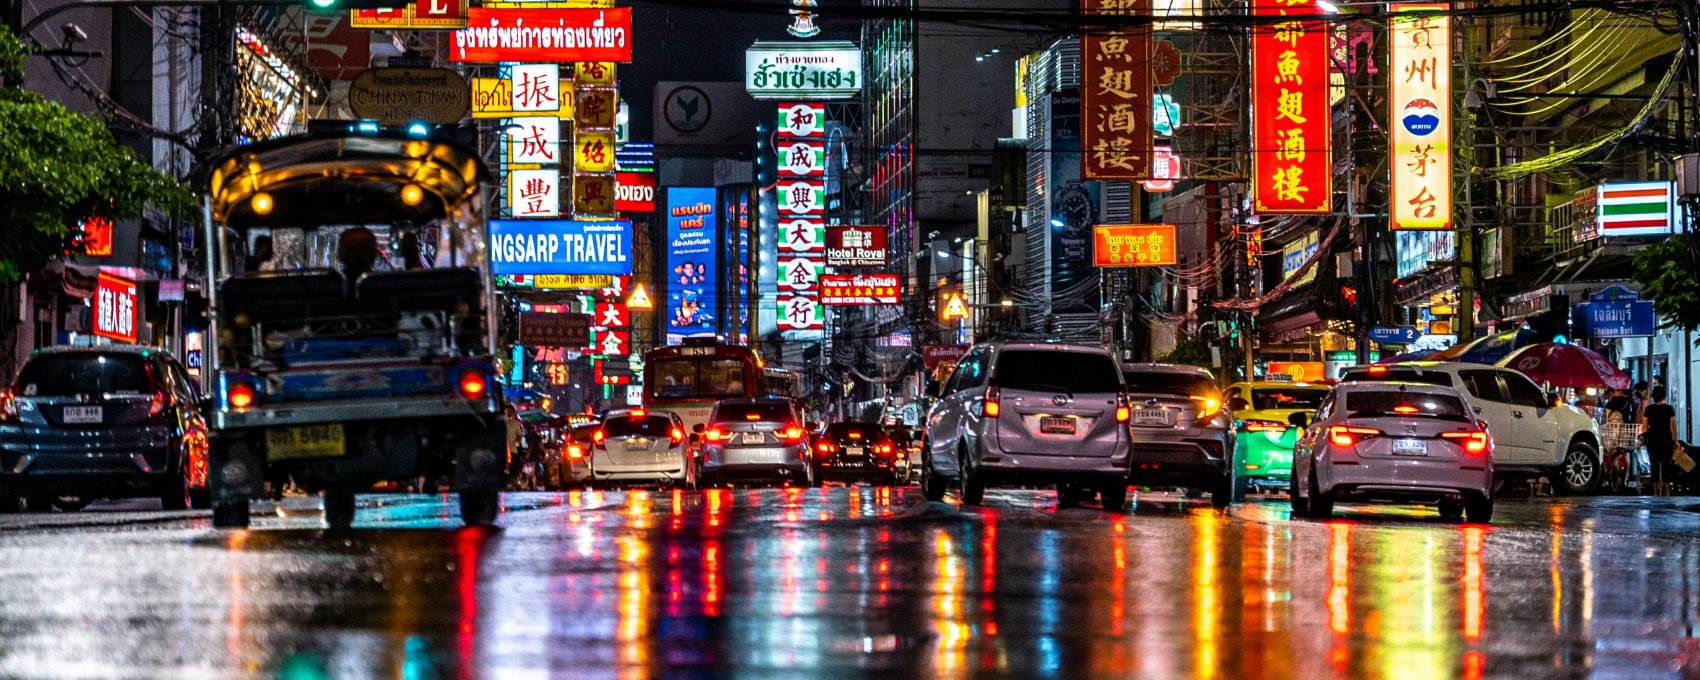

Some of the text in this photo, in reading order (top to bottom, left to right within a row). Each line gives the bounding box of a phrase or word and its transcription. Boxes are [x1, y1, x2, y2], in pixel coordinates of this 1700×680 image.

[456, 11, 625, 59] รุงทรัพย์การท่องเที่ยว
[775, 53, 835, 64] ห้างขายทอง
[1403, 17, 1439, 90] 貴州
[753, 58, 856, 88] ฮั่วเซ่งเฮง
[356, 88, 464, 105] CHINA TOWN
[1272, 0, 1309, 203] 都魚翅酒樓
[514, 72, 557, 214] 振成豐
[1406, 144, 1437, 218] 茅台
[788, 108, 813, 324] 和成興大金行
[491, 233, 627, 263] NGSARP TRAVEL
[827, 248, 885, 258] Hotel Royal
[97, 286, 133, 336] 新唐人超市
[1594, 303, 1632, 326] เฉลิมบุรี
[1406, 329, 1414, 339] 2
[1593, 326, 1633, 335] Chaloem Buri
